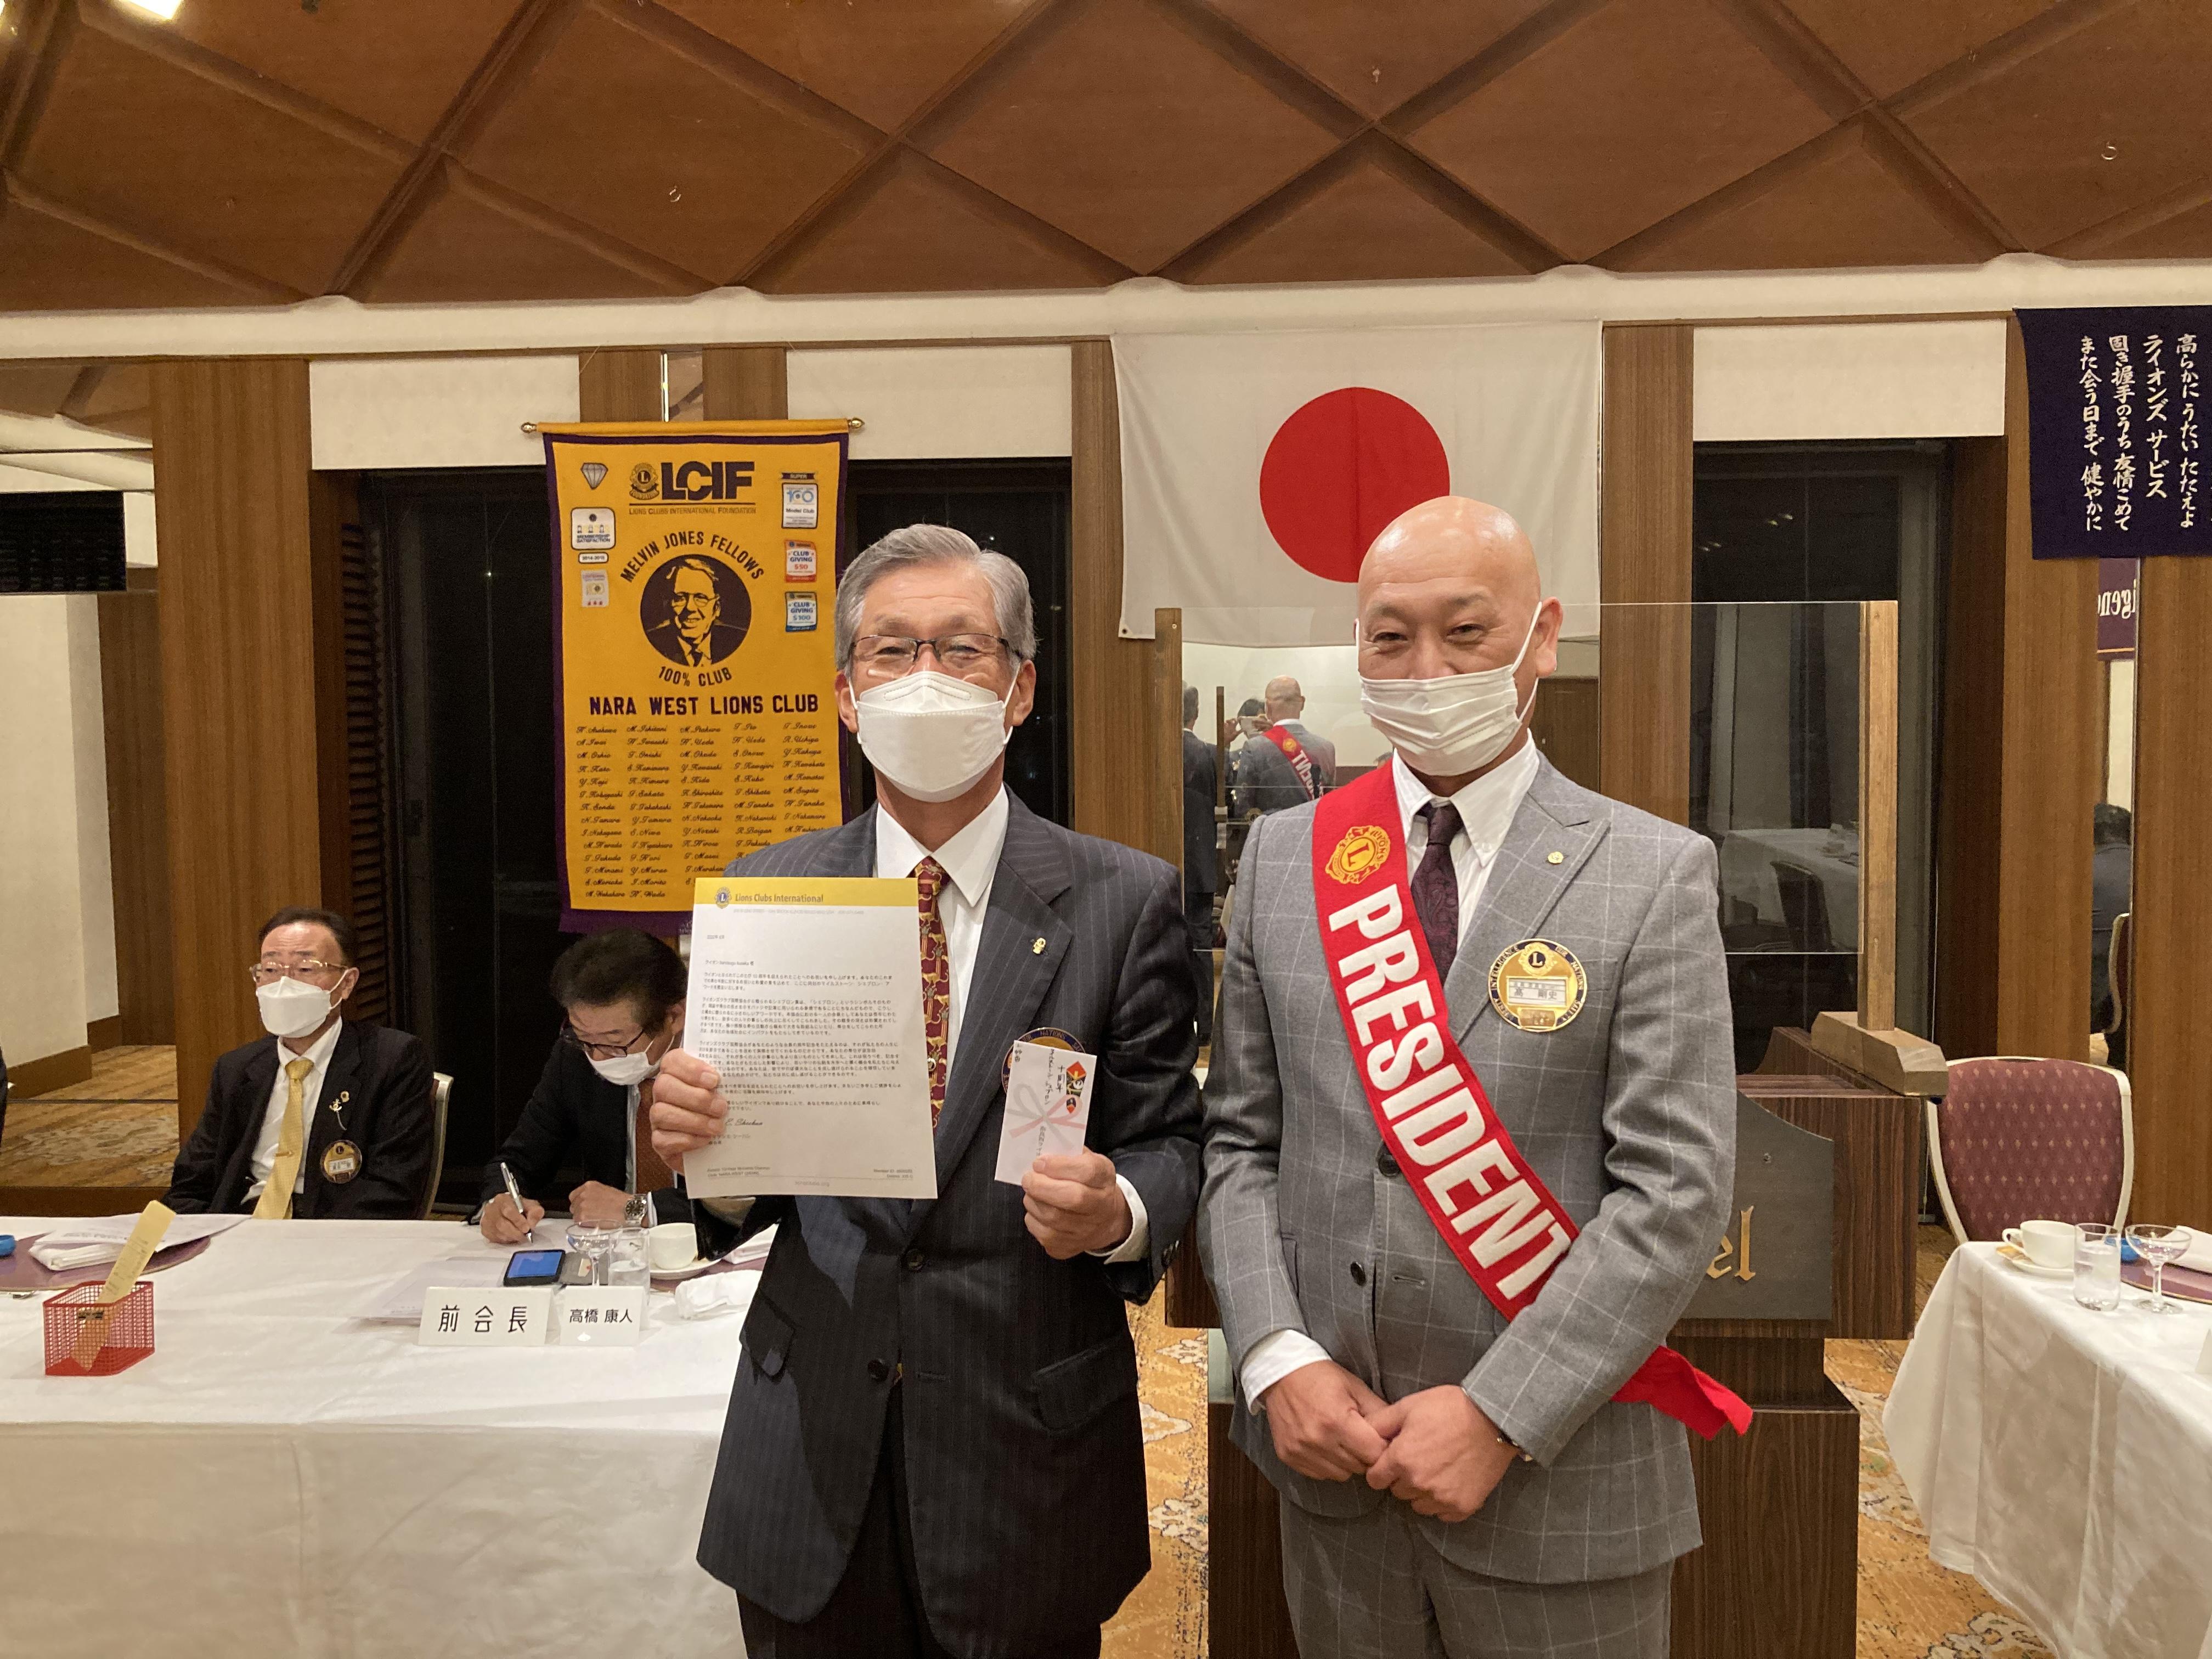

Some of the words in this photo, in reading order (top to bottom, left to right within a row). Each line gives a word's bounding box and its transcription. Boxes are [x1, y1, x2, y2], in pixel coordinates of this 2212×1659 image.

[2108, 335, 2135, 449] 固き握手のうち
[2143, 334, 2169, 422] ライオンズ
[2176, 334, 2199, 398] 高らかに
[2079, 336, 2104, 456] また会う日まで
[2180, 403, 2198, 452] うたい
[661, 461, 755, 500] LCIF
[2113, 453, 2136, 531] 友情こめて
[2146, 429, 2169, 498] サービス
[2180, 457, 2199, 528] たたえよ
[2080, 461, 2104, 531] 健やかに
[620, 541, 659, 583] MELVIN
[664, 531, 704, 549] JONES
[710, 534, 764, 579] FELLOWS
[590, 697, 636, 715] NARA
[650, 697, 698, 715] WEST
[710, 695, 764, 715] LIONS
[773, 694, 819, 713] CLUB
[659, 666, 690, 686] 100%
[698, 667, 732, 686] CLUB
[754, 894, 772, 902] Clubs
[774, 894, 823, 902] International
[1491, 945, 1519, 990] INTELLIGENCE
[1532, 952, 1543, 966] L
[1328, 884, 1572, 1299] PRESIDENT
[569, 1308, 599, 1323] 高橋
[604, 1308, 633, 1324] 康人
